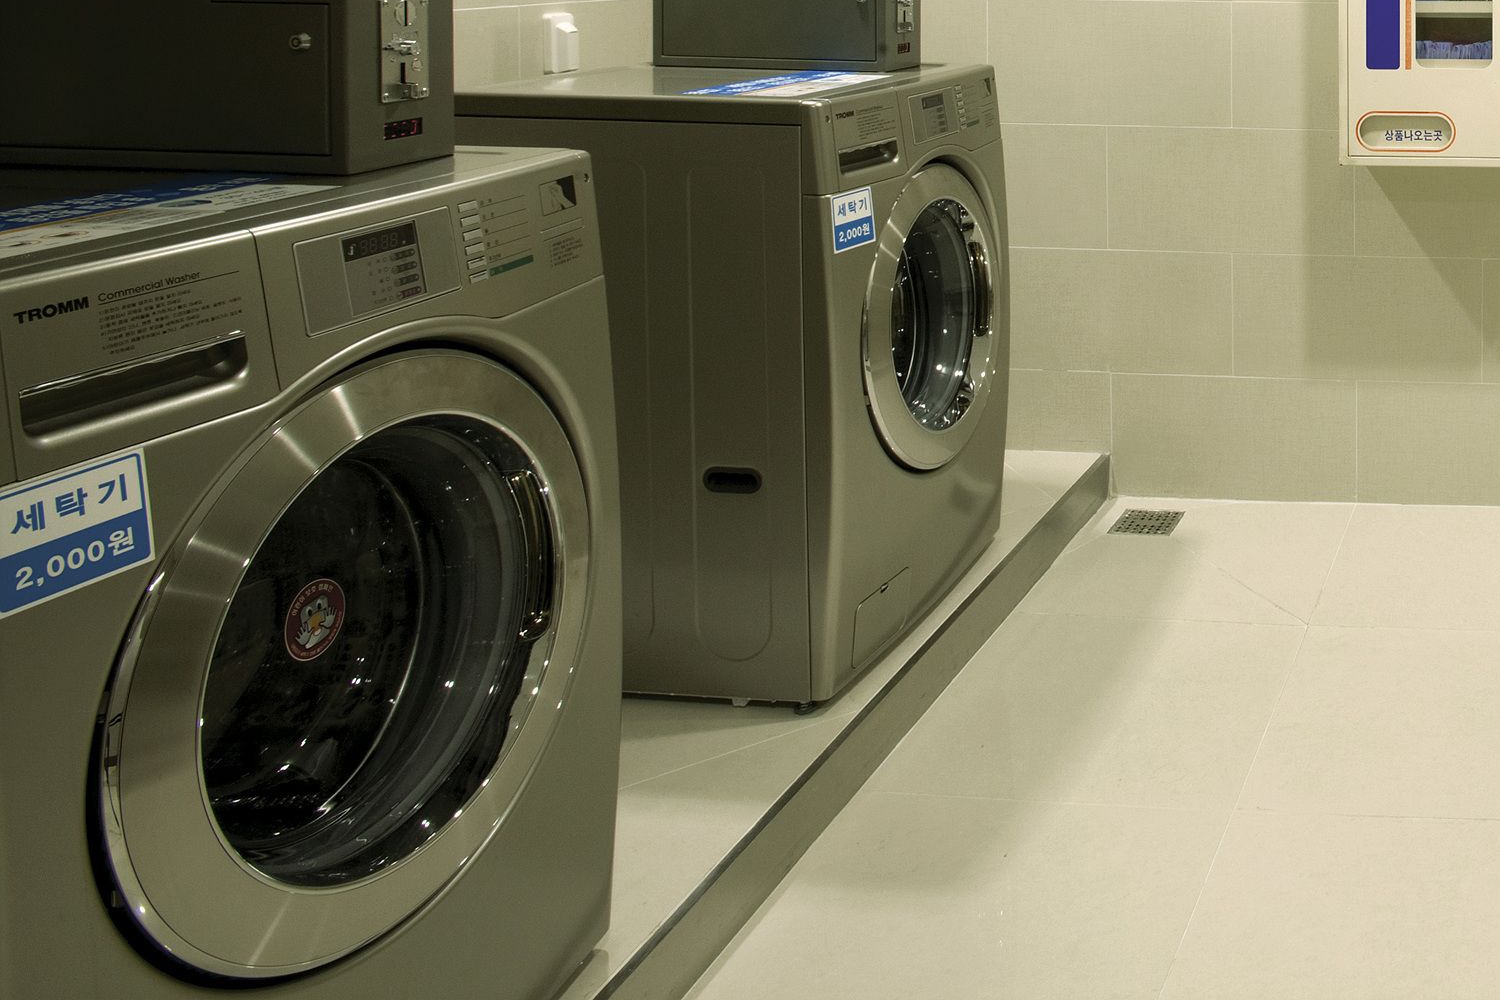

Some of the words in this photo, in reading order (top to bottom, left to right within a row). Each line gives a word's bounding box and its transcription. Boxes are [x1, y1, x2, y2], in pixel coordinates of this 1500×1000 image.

[1385, 130, 1442, 141] 상품나오는곳
[837, 198, 868, 216] 세탁기
[839, 223, 871, 243] 2,000원
[98, 279, 163, 302] Commercial
[165, 271, 201, 286] Washer
[13, 296, 90, 324] TROMM
[10, 473, 127, 534] 세탁기
[15, 526, 135, 591] 2,000원
